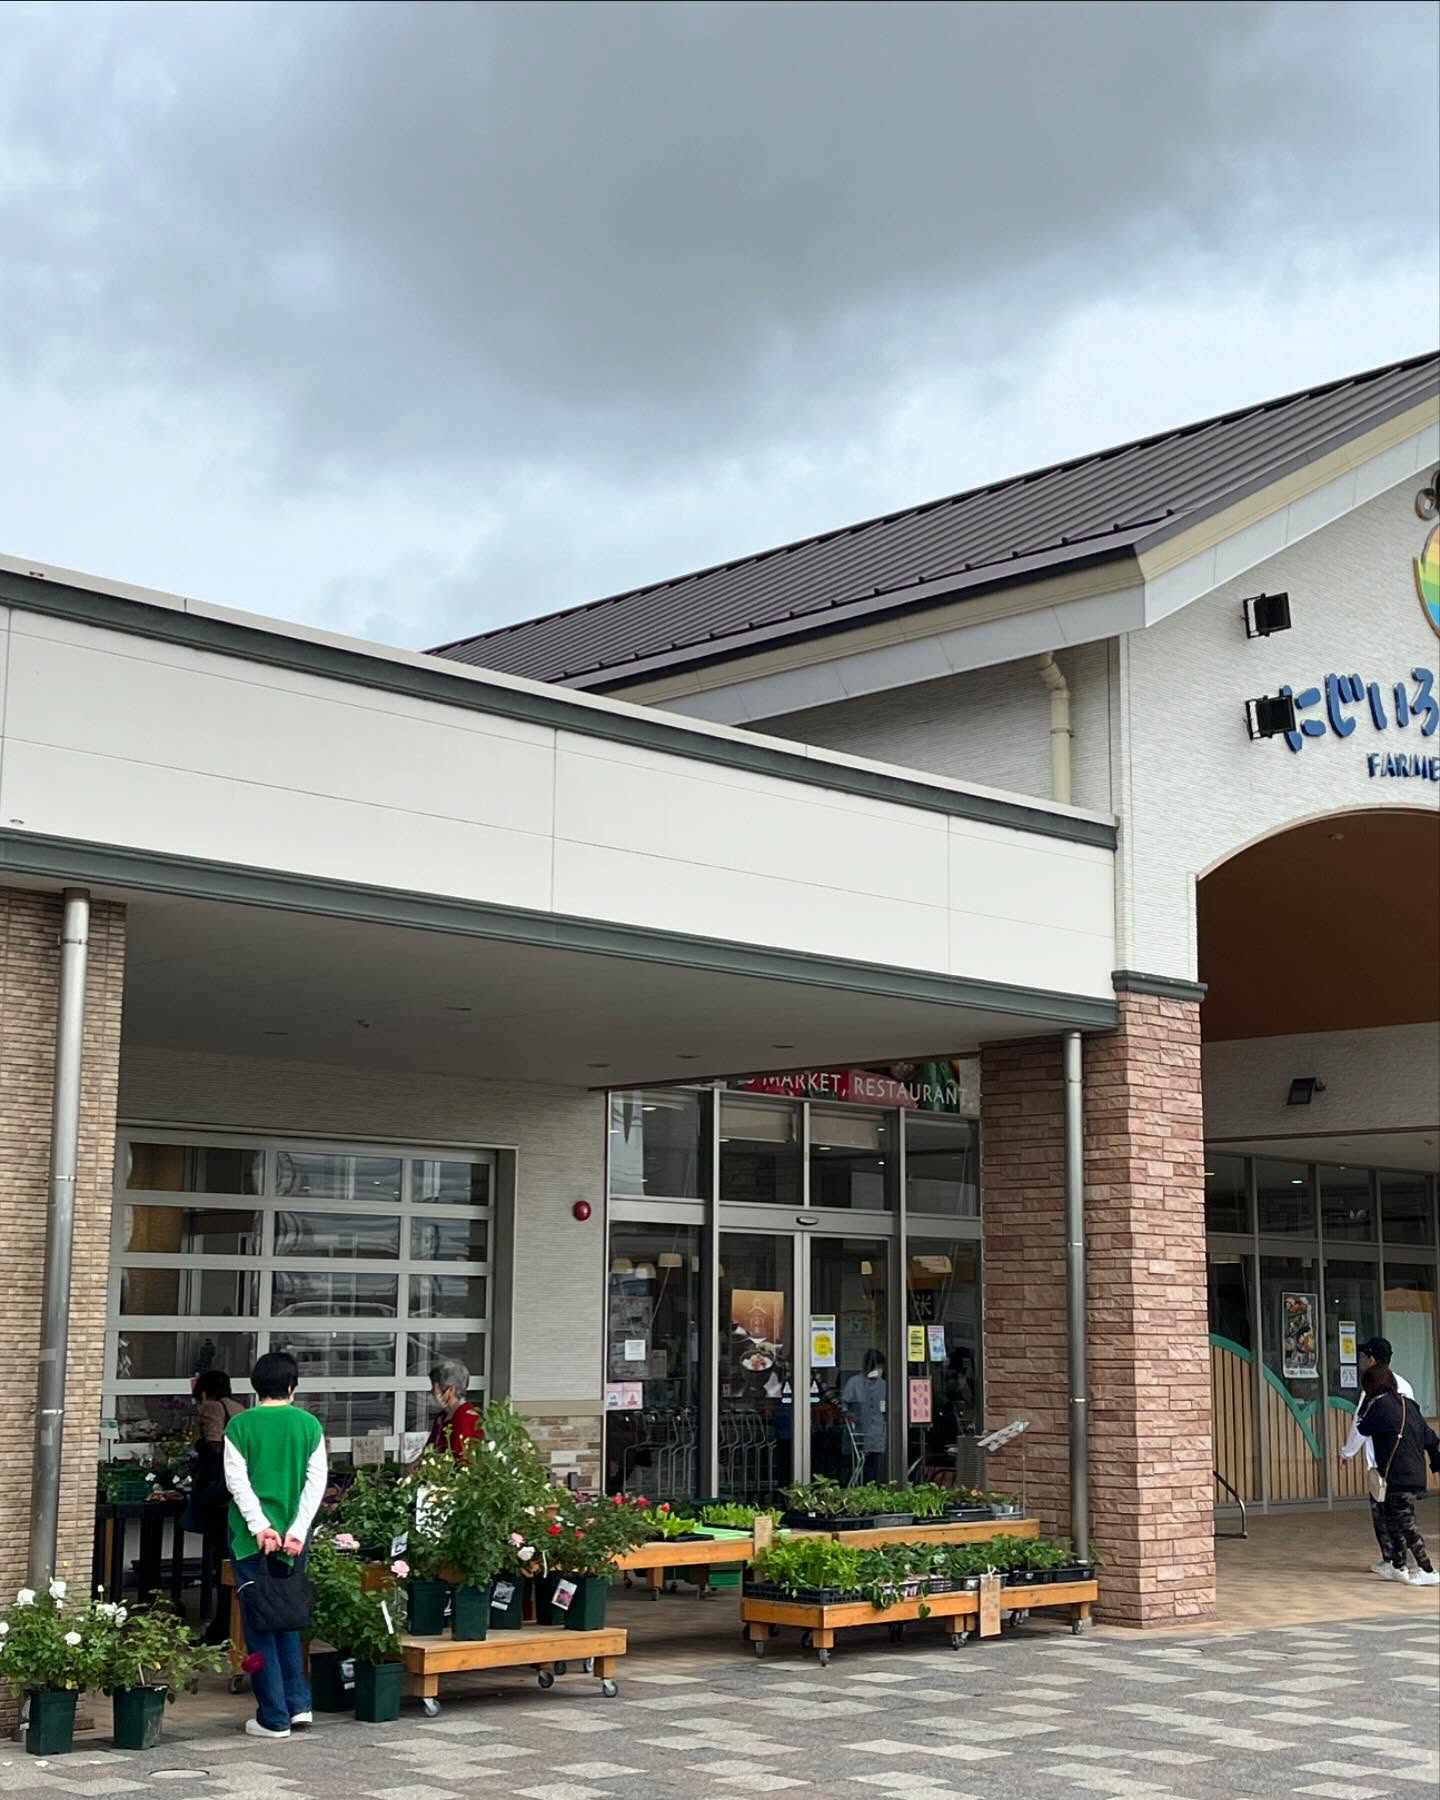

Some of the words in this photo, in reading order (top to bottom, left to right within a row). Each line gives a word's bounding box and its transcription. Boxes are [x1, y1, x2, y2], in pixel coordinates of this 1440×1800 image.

[1279, 667, 1440, 753] にじいろ
[1367, 752, 1440, 781] FARME
[854, 1077, 968, 1105] RESTAURANT
